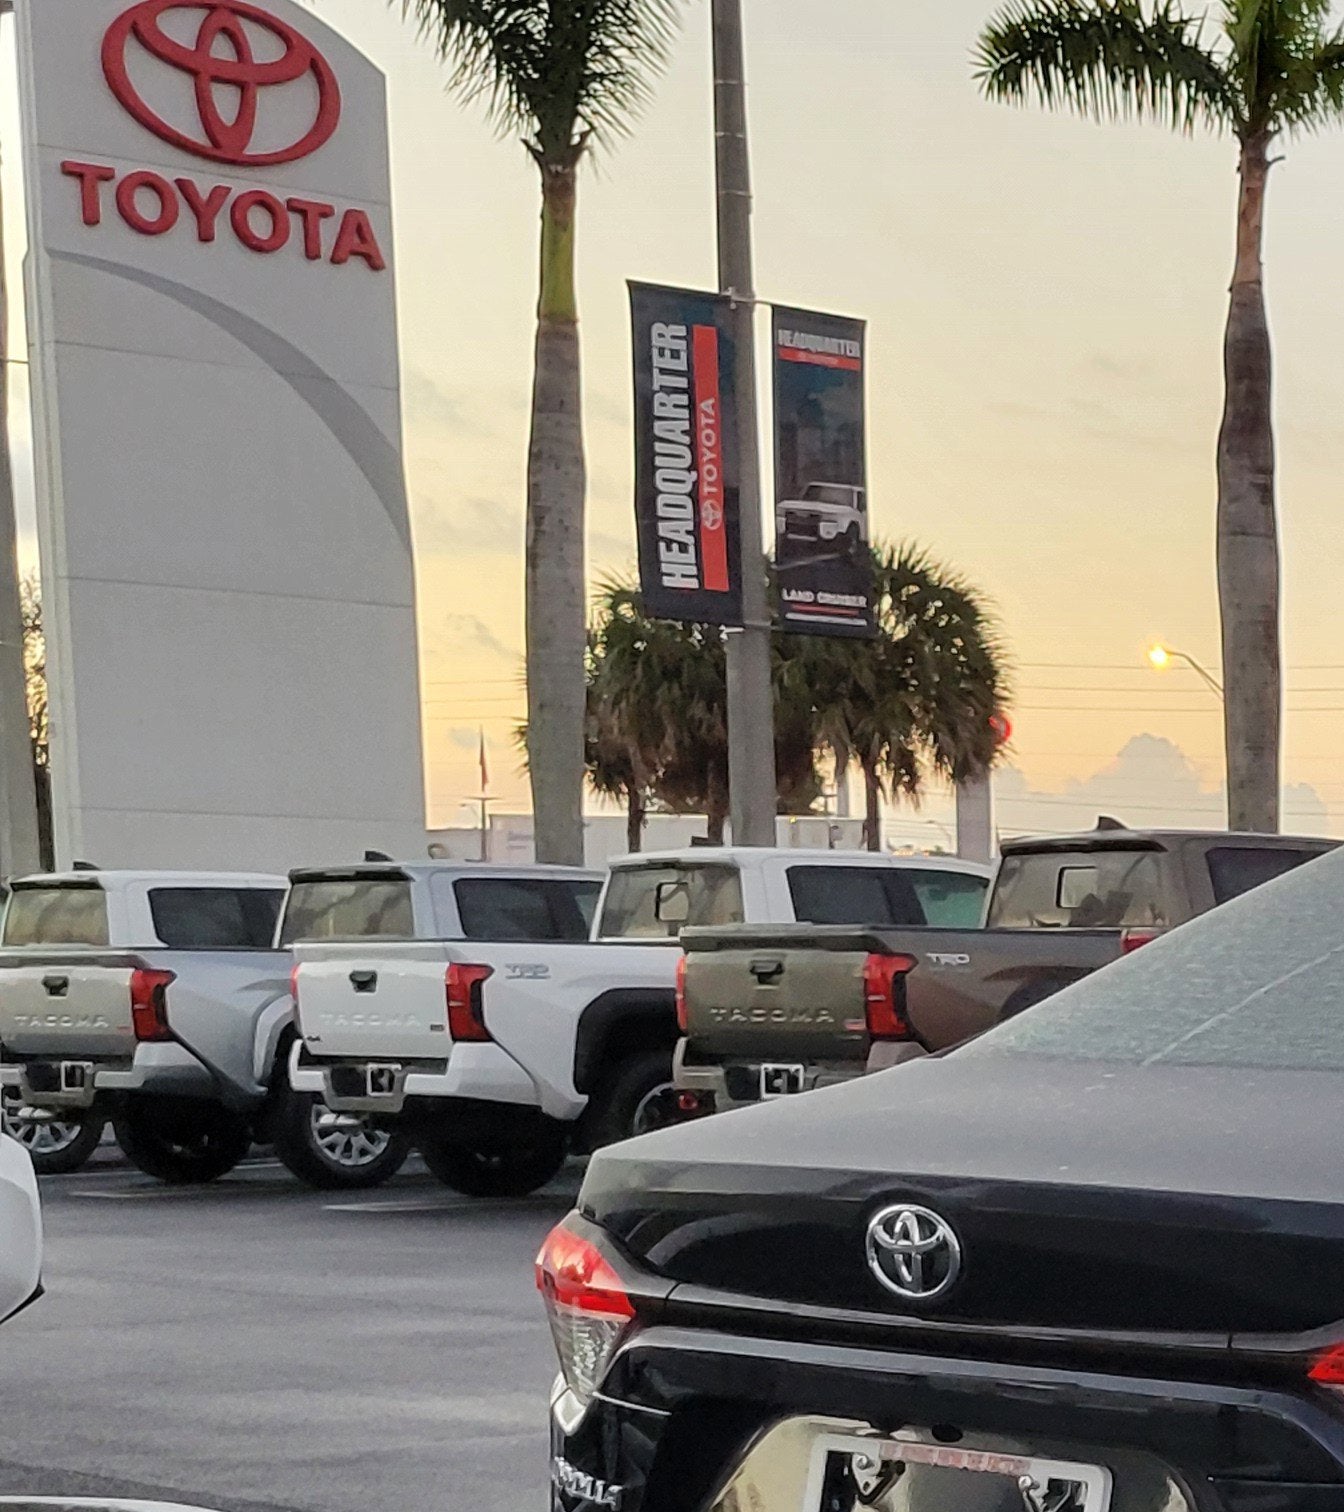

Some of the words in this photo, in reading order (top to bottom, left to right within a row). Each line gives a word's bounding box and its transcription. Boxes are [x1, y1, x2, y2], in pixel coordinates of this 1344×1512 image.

[61, 160, 386, 271] TOYOTA
[651, 321, 699, 590] HEADQUARTER
[702, 398, 718, 494] TOYOTA
[926, 953, 970, 967] TRD
